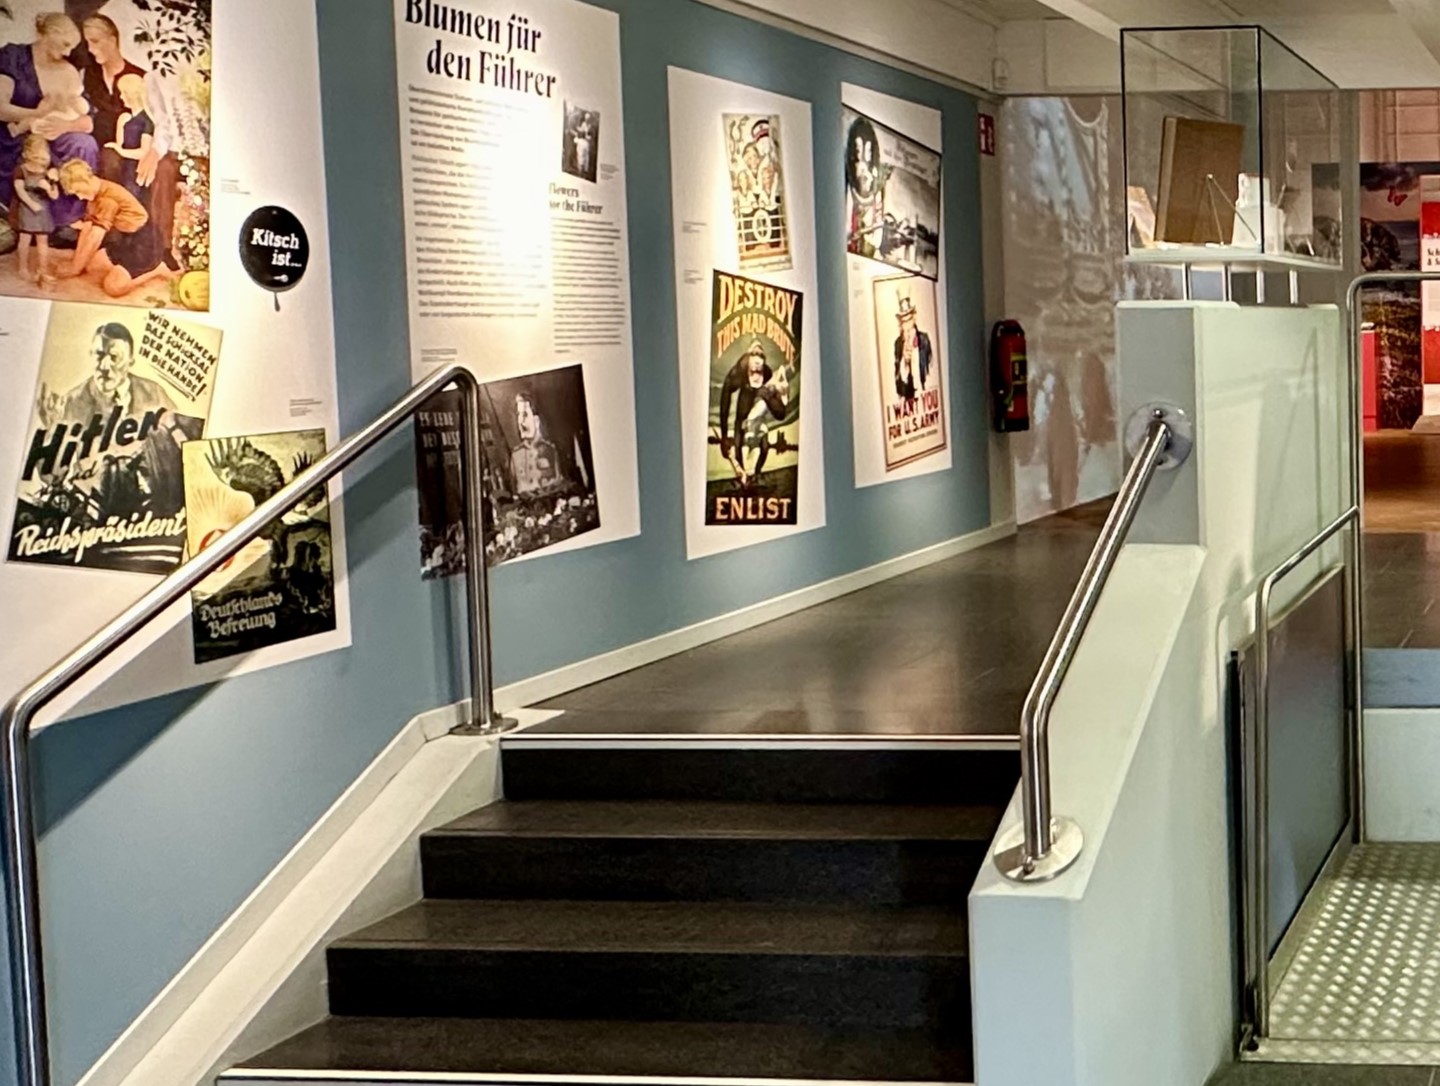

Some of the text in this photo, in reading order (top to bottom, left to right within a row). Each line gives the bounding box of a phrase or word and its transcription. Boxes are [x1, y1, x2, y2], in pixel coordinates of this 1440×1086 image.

[405, 0, 541, 53] Blumen für
[427, 40, 556, 98] den Führer
[250, 228, 300, 249] Kitsch
[717, 275, 798, 338] DESTROY
[139, 346, 151, 359] IN
[151, 354, 167, 369] DIE
[142, 334, 204, 383] DER NATION
[145, 322, 209, 374] DAS SCHICKSAL
[149, 310, 217, 366] WIR NEHMEN
[717, 316, 740, 359] THIS
[741, 313, 766, 336] MAD
[886, 389, 938, 423] I WANT YOU
[22, 405, 167, 481] Hitler
[715, 497, 791, 520] ENLIST
[14, 506, 188, 563] Reichspräsident
[200, 591, 283, 621] Deutschlands
[207, 611, 276, 638] Befreiung
